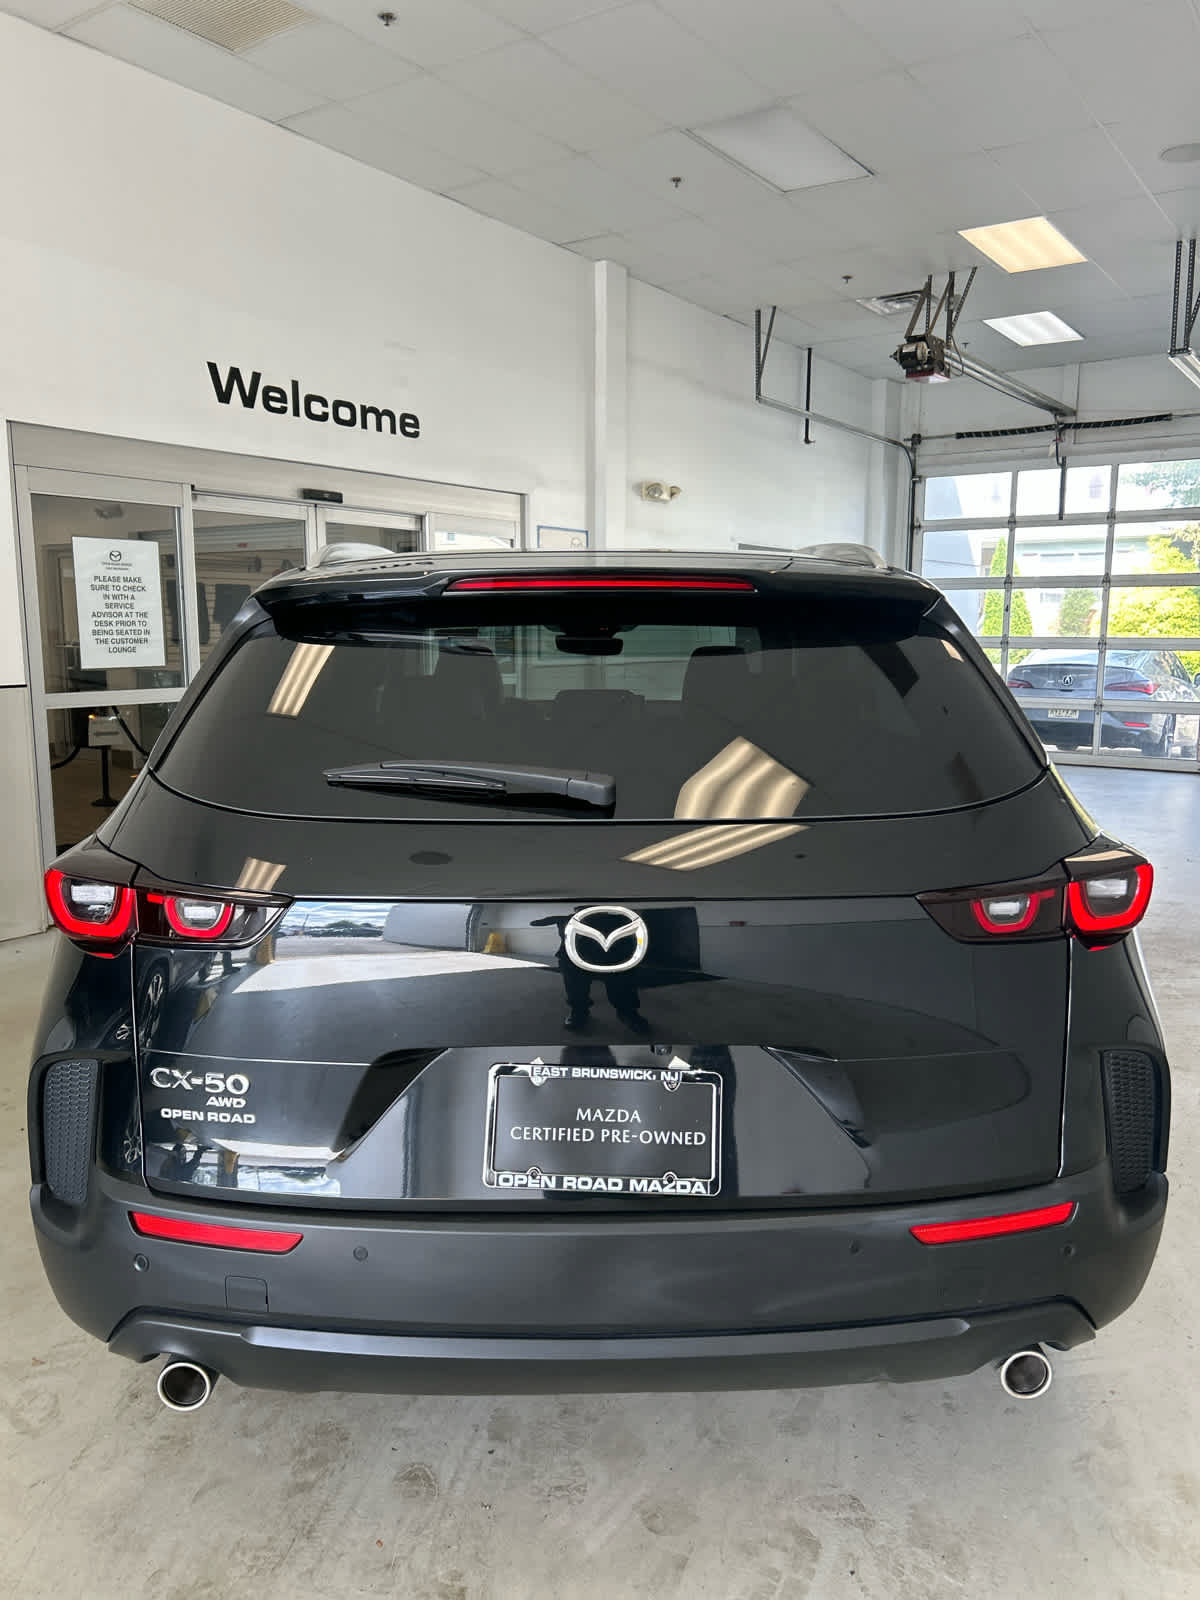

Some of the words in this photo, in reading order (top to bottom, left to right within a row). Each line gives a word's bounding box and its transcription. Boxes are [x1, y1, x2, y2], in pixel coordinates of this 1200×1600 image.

[206, 361, 420, 439] Welcome
[94, 575, 121, 583] PLEASE
[111, 593, 129, 601] WITH
[150, 1067, 250, 1095] CX-50
[532, 1067, 569, 1078] EAST
[572, 1068, 656, 1081] BRUNSWICK,
[660, 1071, 680, 1083] NJ
[206, 1096, 246, 1108] AWD
[160, 1108, 204, 1121] OPEN
[207, 1112, 256, 1124] ROAD
[576, 1108, 641, 1123] MAZDA
[510, 1127, 594, 1142] CERTIFIED
[600, 1129, 706, 1145] PRE-OWNED
[498, 1175, 556, 1188] OPEN
[563, 1177, 623, 1191] ROAD
[629, 1178, 707, 1194] MAZDA
